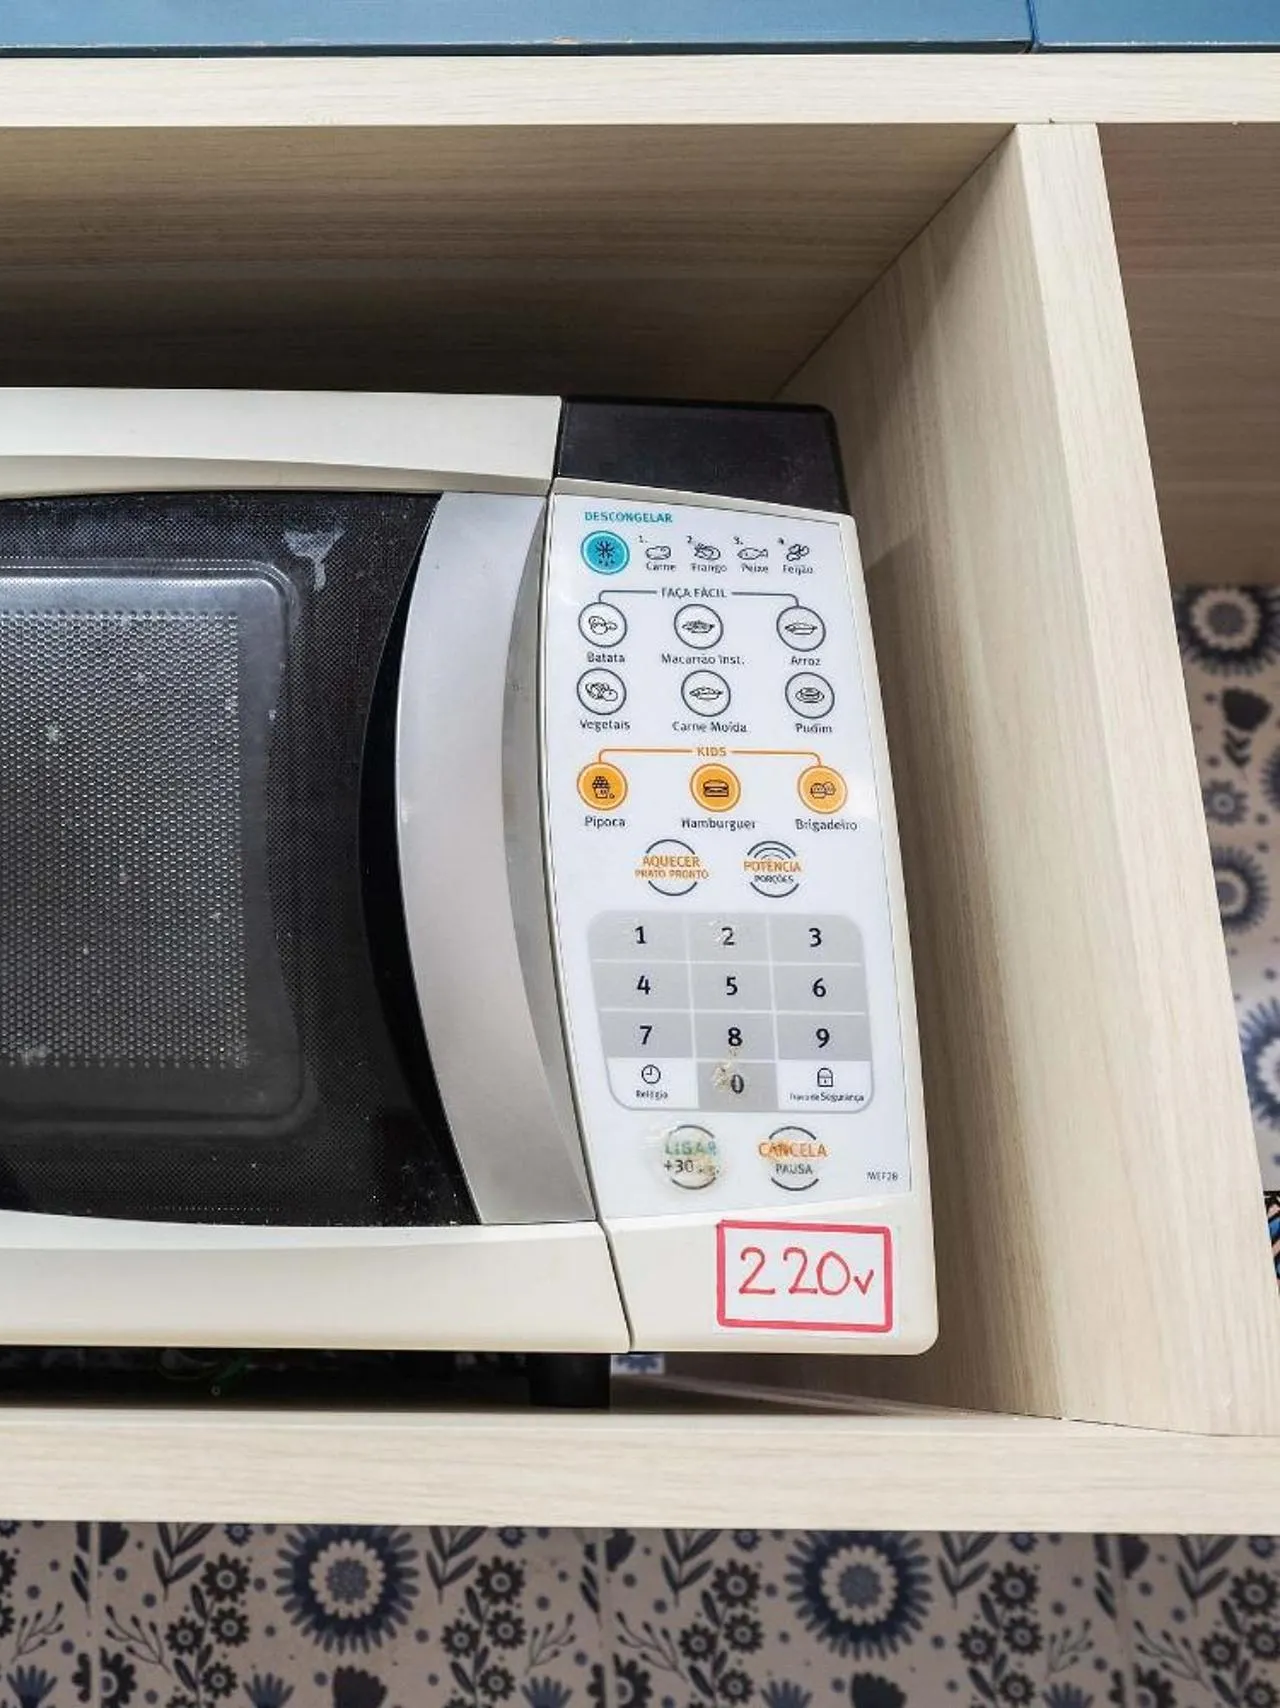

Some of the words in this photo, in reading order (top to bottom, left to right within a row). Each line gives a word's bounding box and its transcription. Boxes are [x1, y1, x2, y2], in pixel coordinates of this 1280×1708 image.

[584, 511, 673, 523] DESCONGELAR
[646, 562, 676, 572] Carne
[661, 587, 691, 600] FAÇA
[587, 652, 625, 664] Batata
[661, 654, 716, 665] Macarrão
[790, 656, 821, 667] Arroz
[580, 719, 631, 731] Vegetais
[672, 721, 706, 732] Carne
[795, 722, 833, 734] Pudim
[696, 746, 727, 757] KIDS
[584, 816, 626, 829] Pipoca
[681, 818, 756, 831] Hamburguer
[795, 819, 858, 831] Brigadeiro
[642, 856, 701, 868] AQUECER
[635, 869, 667, 878] PRATO
[669, 870, 709, 880] PRONTO
[634, 926, 647, 944] 1
[722, 927, 735, 946] 2
[808, 928, 822, 947] 3
[637, 975, 651, 995] 4
[726, 976, 738, 996] 5
[812, 977, 827, 998] 6
[639, 1025, 653, 1045] 7
[728, 1027, 743, 1047] 8
[815, 1028, 830, 1048] 9
[730, 1074, 745, 1094] 0
[758, 1142, 828, 1157] CANCELA
[775, 1163, 813, 1175] PAUSA
